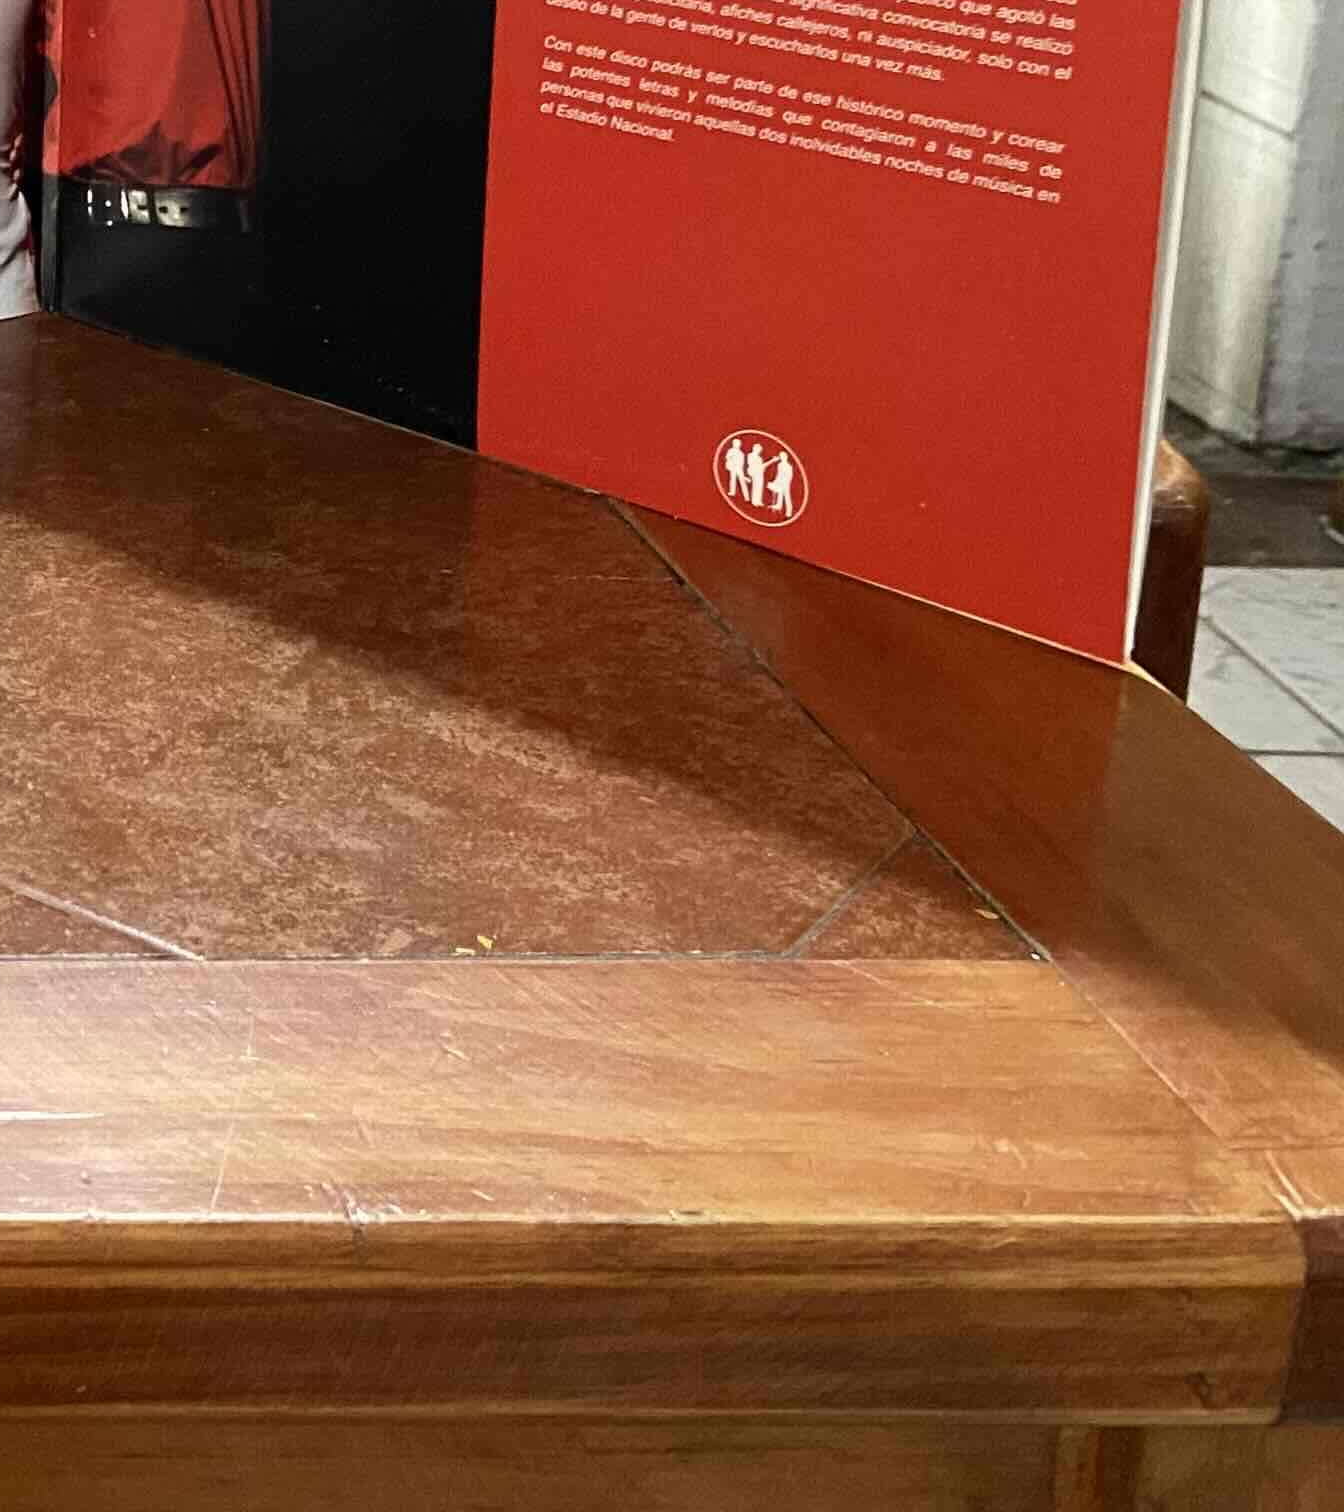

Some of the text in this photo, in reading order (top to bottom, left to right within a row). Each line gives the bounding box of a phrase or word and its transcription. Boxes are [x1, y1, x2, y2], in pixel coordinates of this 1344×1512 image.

[542, 57, 564, 73] las
[570, 66, 631, 87] potentes
[639, 77, 680, 97] letras
[687, 89, 698, 104] y
[782, 110, 813, 126] que
[821, 119, 916, 147] contagiaron
[924, 140, 937, 153] a
[946, 143, 973, 160] las
[982, 153, 1029, 172] miles
[1039, 164, 1063, 179] de
[544, 35, 573, 52] Con
[576, 44, 607, 60] este
[610, 50, 648, 68] disco
[705, 71, 731, 85] ser
[733, 77, 774, 94] parte
[777, 85, 798, 100] de
[802, 91, 832, 106] ese
[909, 113, 987, 138] momento
[990, 130, 1005, 145] y
[1008, 134, 1064, 153] corear
